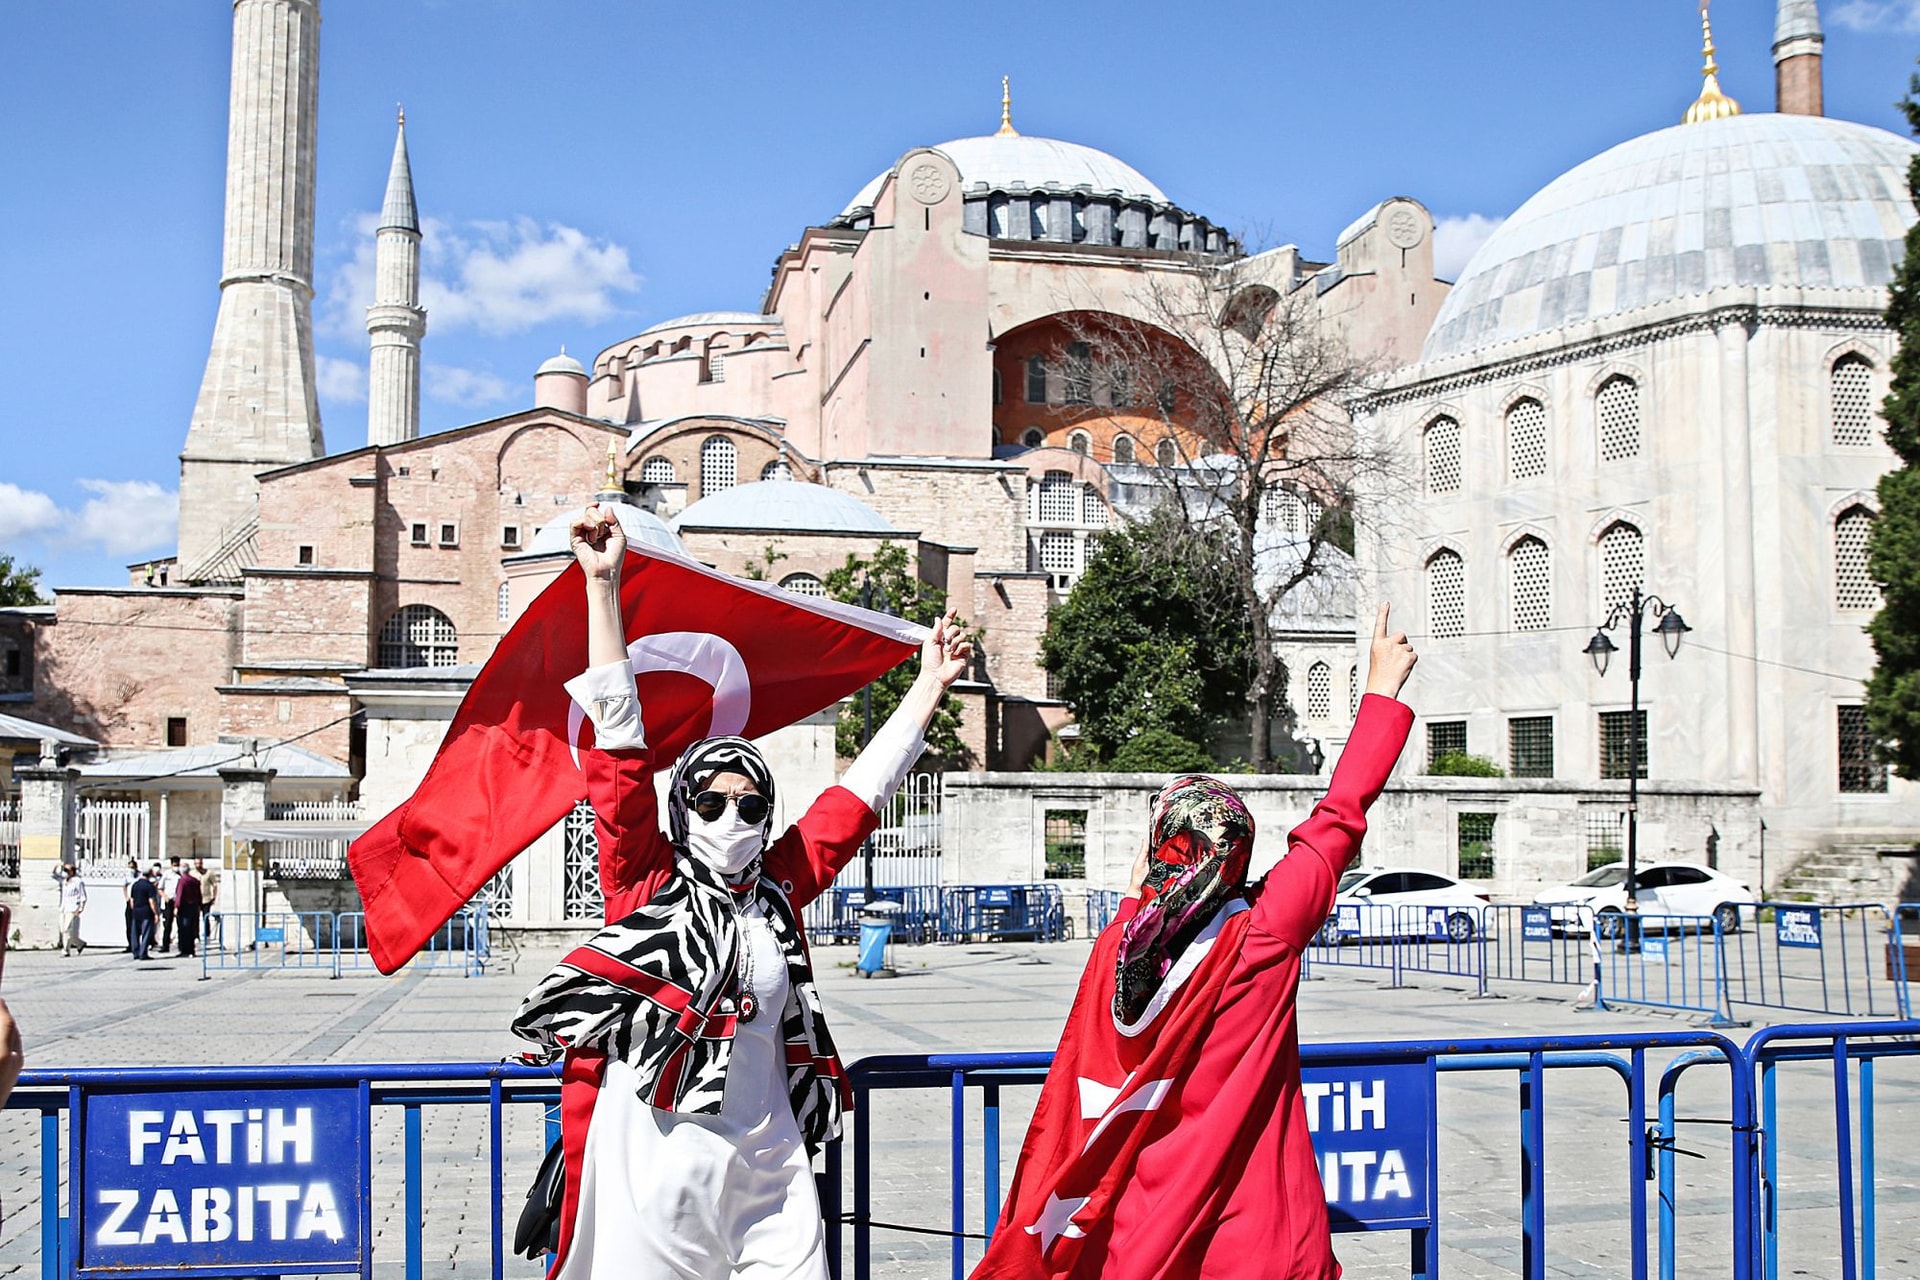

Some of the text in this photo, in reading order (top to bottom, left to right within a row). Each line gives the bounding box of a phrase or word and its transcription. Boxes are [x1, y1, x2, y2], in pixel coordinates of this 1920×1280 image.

[1302, 1079, 1386, 1132] TiH
[1322, 1149, 1413, 1203] ITA
[96, 1182, 345, 1245] ZABITA
